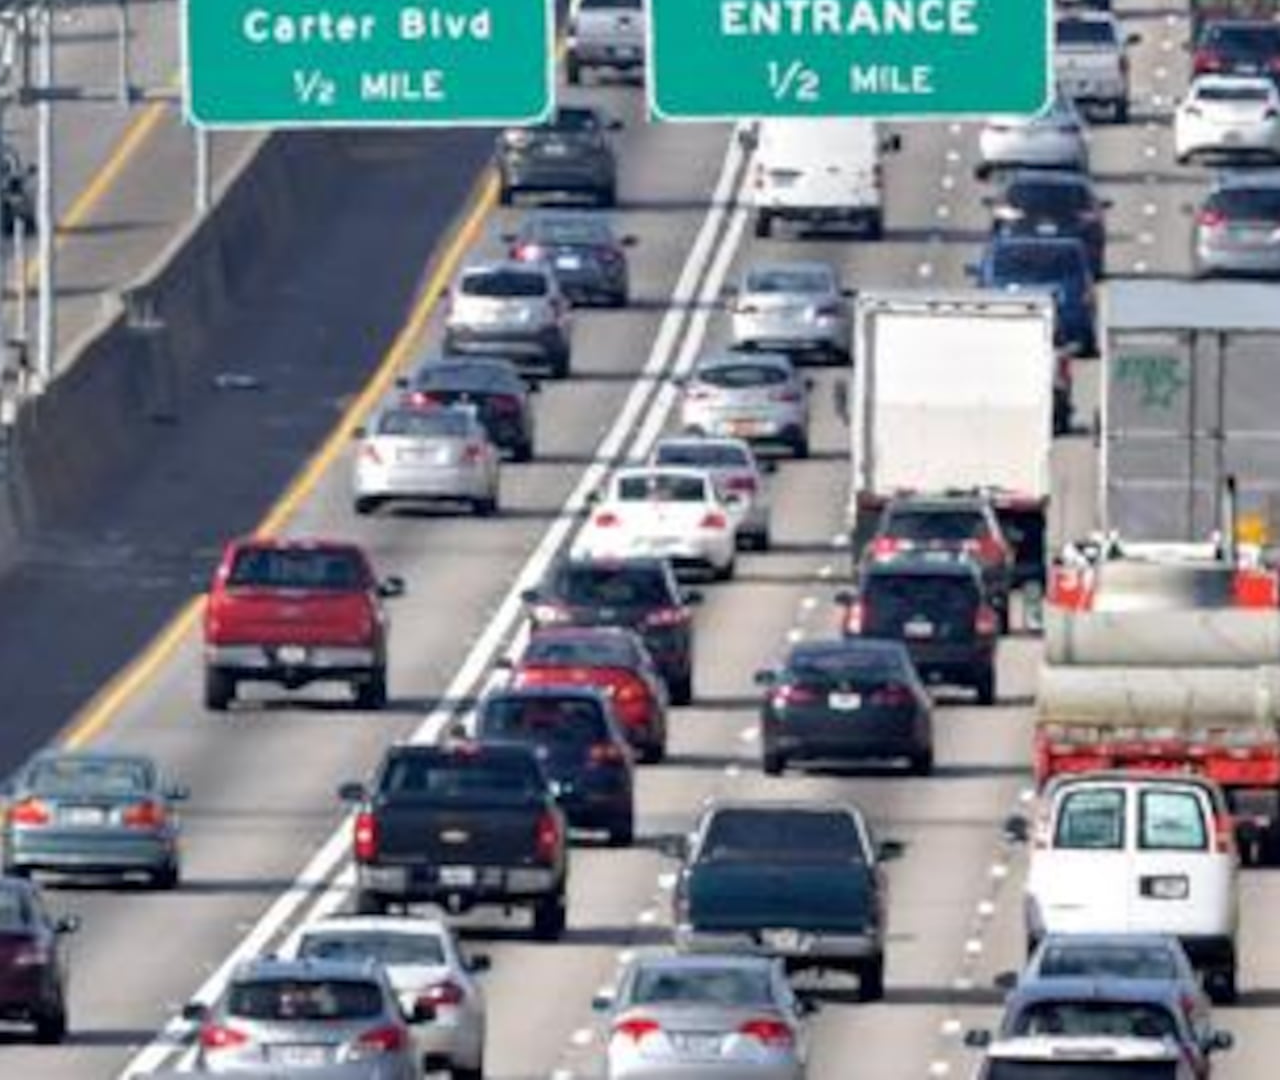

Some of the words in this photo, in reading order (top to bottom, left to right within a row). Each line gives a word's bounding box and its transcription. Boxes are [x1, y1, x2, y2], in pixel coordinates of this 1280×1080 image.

[242, 8, 377, 43] Carter
[399, 7, 493, 41] Blvd
[360, 70, 447, 101] MILE
[849, 63, 936, 95] MILE
